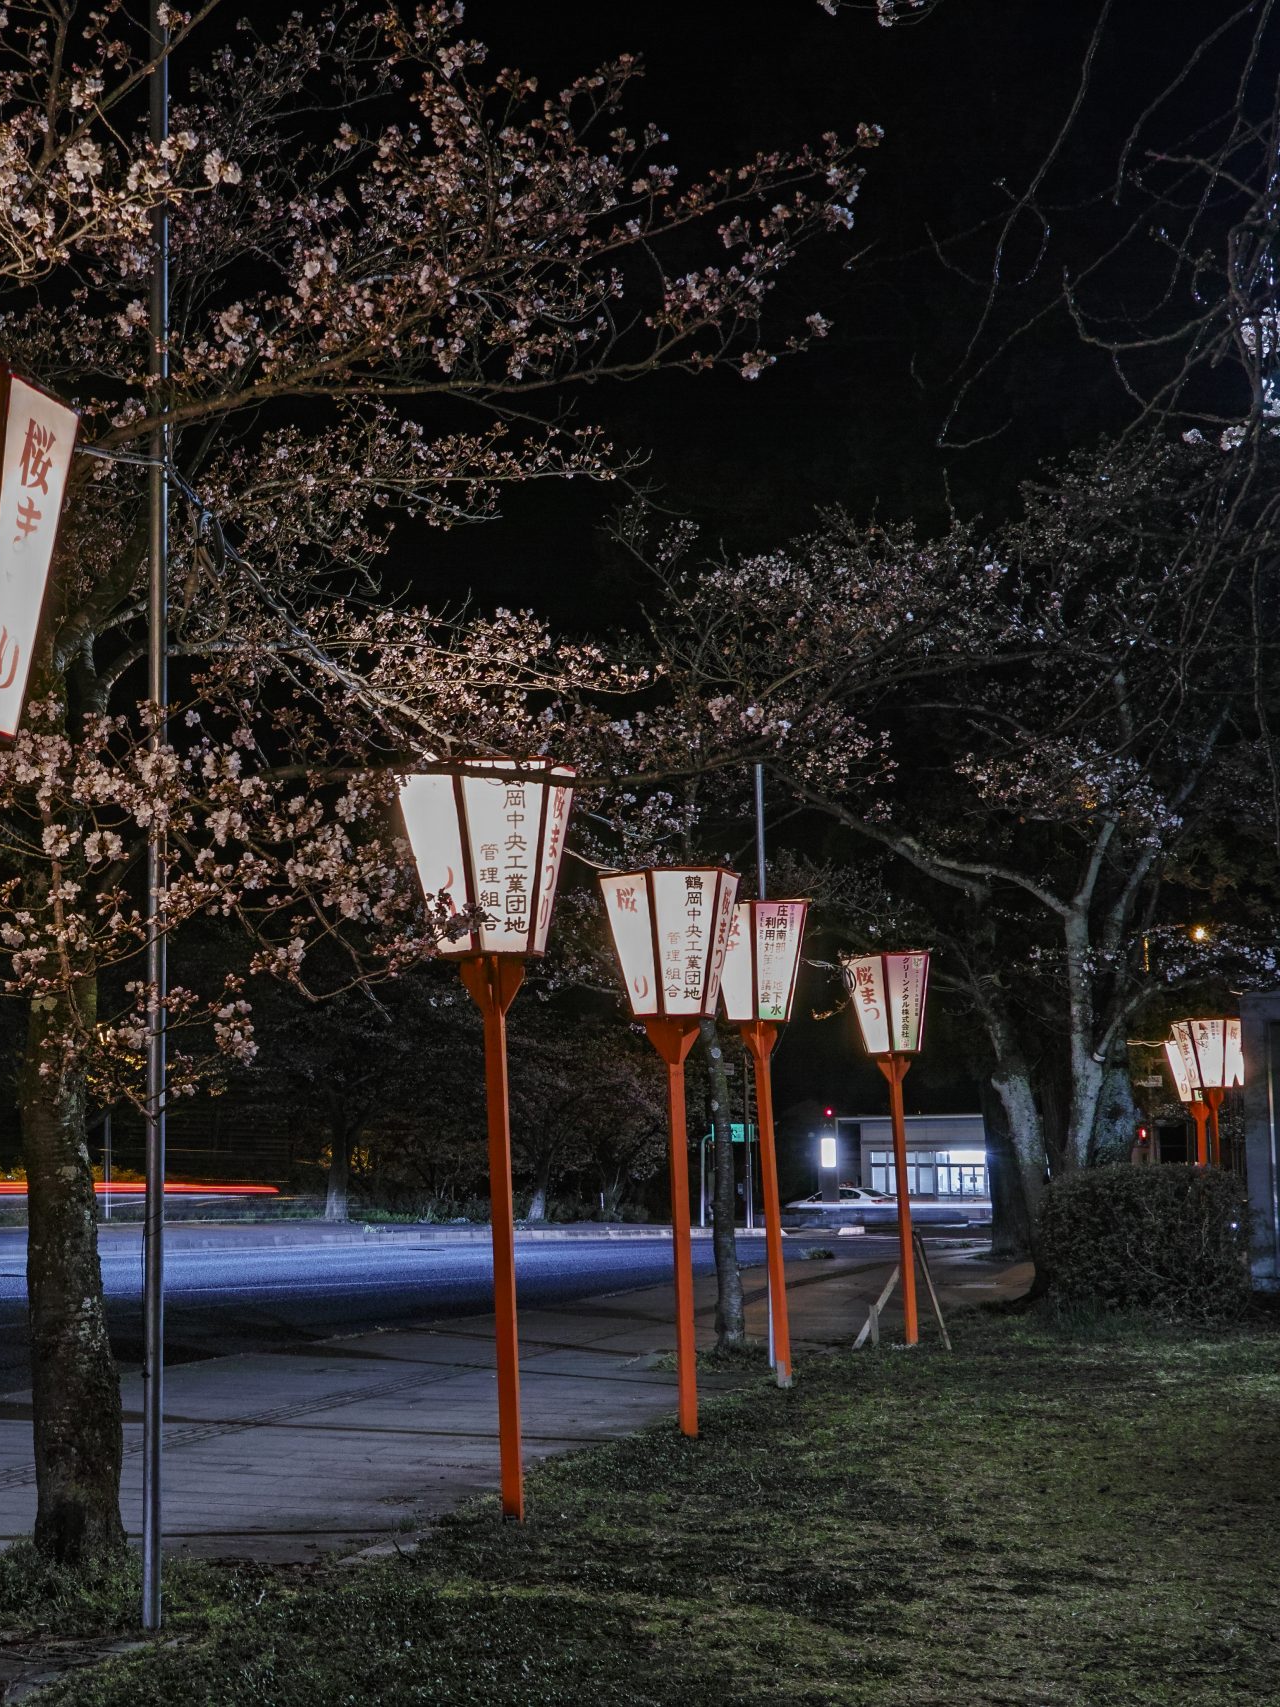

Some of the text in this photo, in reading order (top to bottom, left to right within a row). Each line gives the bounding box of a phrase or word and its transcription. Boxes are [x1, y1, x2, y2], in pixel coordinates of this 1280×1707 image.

[479, 843, 502, 932] 管理組合
[503, 780, 529, 934] 岡中央工業団地
[539, 787, 569, 930] 桜まつり
[664, 931, 682, 999] 管理組合
[683, 875, 705, 1001] 鶴岡中央工業団地
[709, 885, 733, 1000] 桜まつり
[770, 904, 789, 1016] 庄内南部地下水
[855, 965, 881, 1021] 桜まつ
[900, 957, 911, 1039] グリーンメタル株式会社
